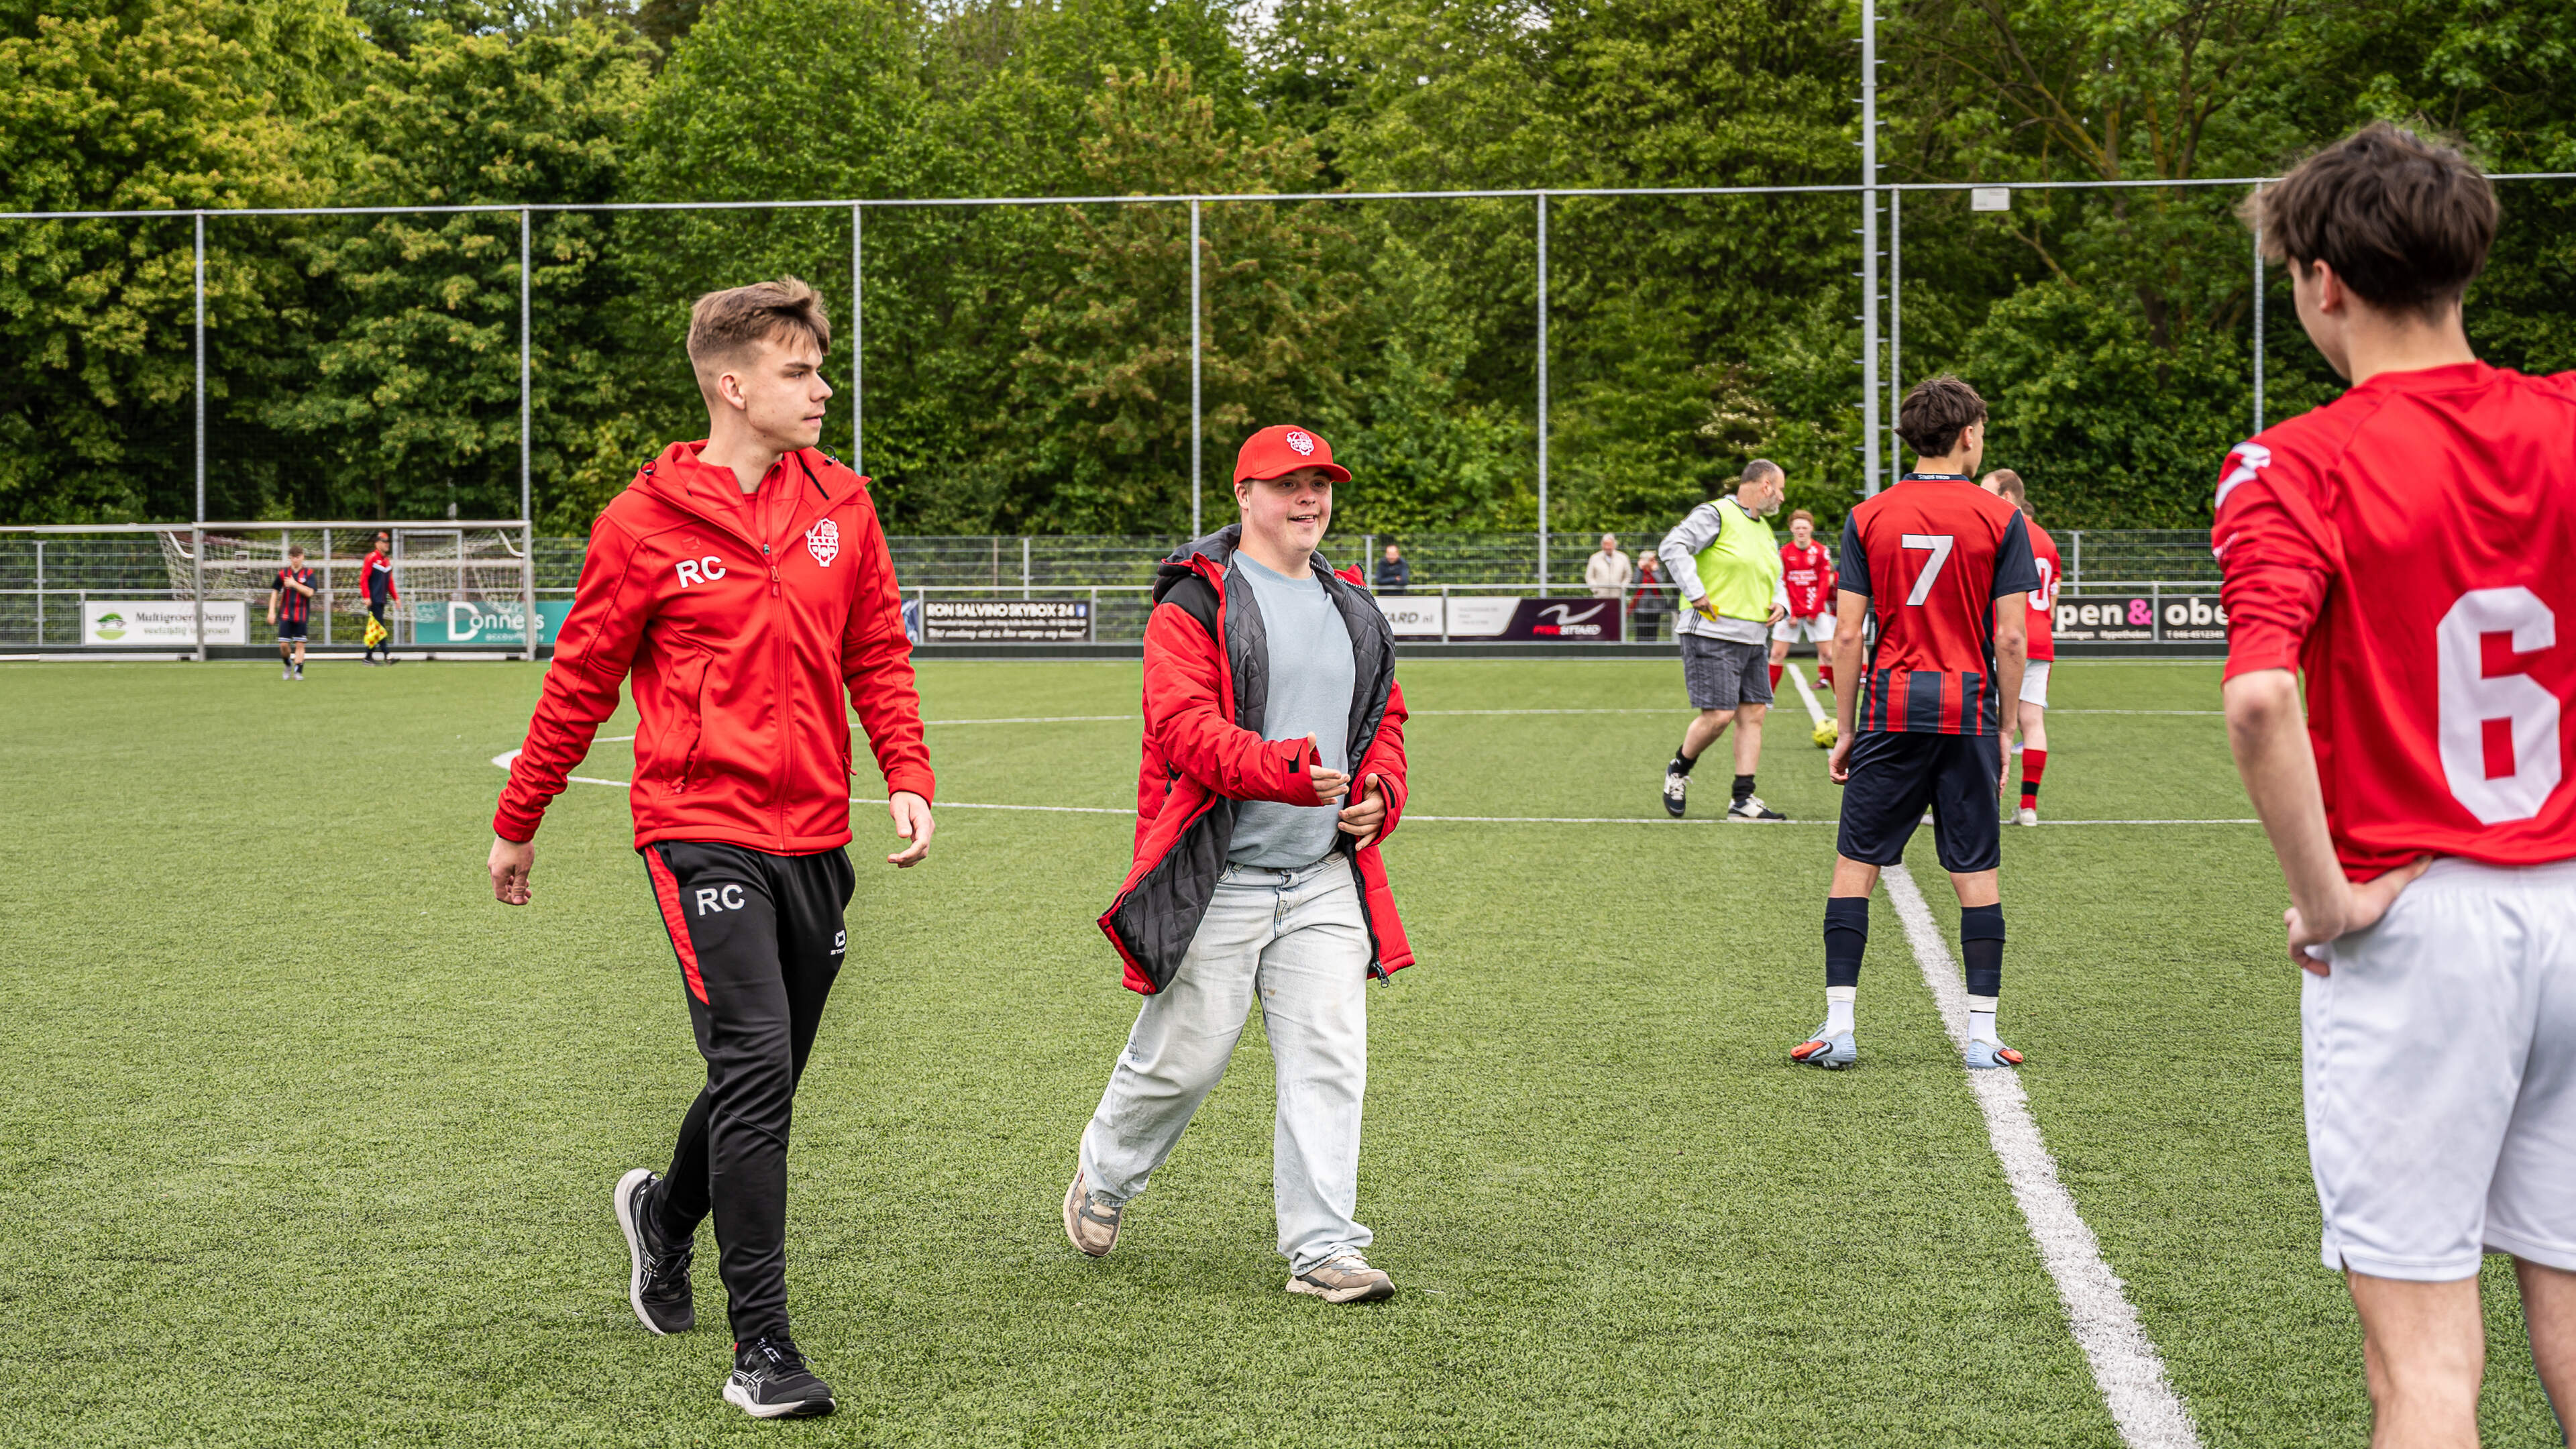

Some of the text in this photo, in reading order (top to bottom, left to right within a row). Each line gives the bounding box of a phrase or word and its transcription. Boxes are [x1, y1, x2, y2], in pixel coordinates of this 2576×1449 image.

[676, 556, 726, 588] RC
[1901, 533, 1954, 606] 7
[2029, 557, 2052, 611] 0
[447, 601, 545, 641] Donnes
[926, 603, 954, 617] RON
[955, 603, 1008, 617] SALVINO
[1008, 603, 1057, 617] SKYBOX
[1057, 603, 1075, 617] 24
[2056, 603, 2123, 632] pen
[2127, 598, 2153, 625] &
[2436, 586, 2561, 825] 6
[696, 885, 745, 916] RC
